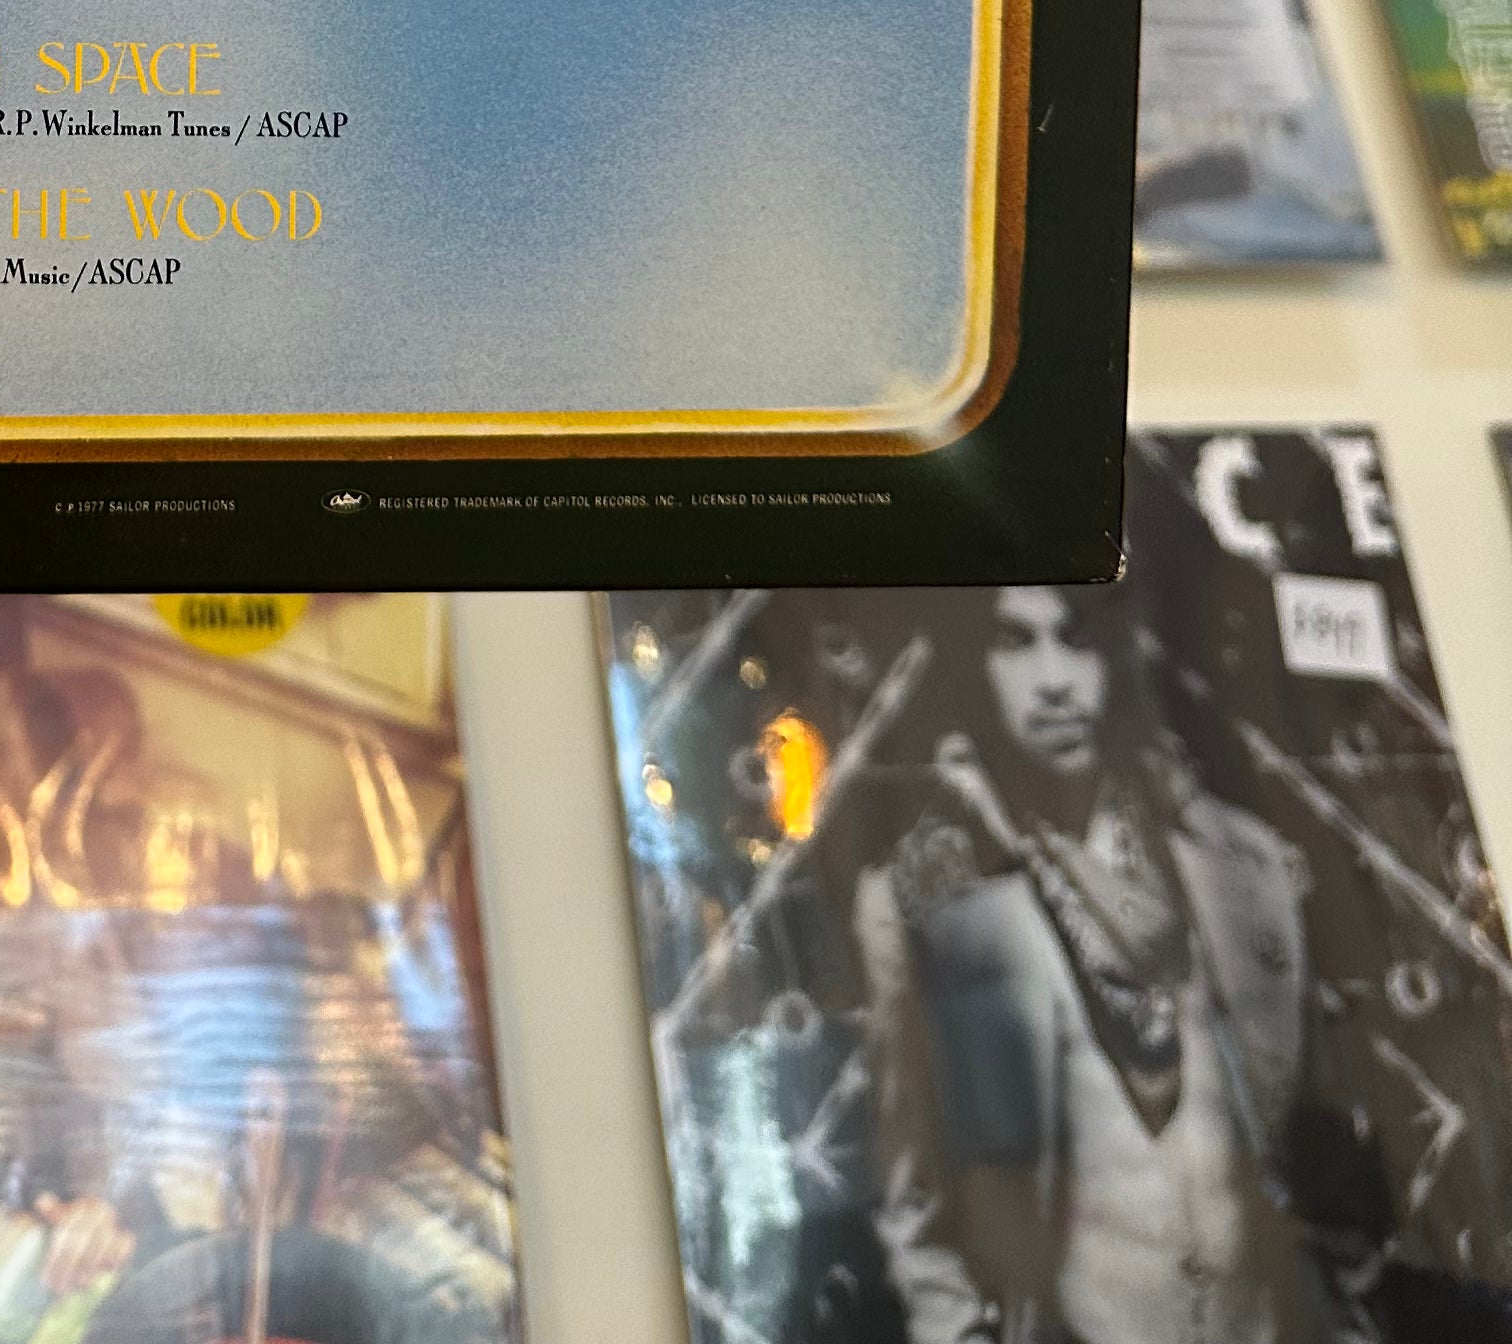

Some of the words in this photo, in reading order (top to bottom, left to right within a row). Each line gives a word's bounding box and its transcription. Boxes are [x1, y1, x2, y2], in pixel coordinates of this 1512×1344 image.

[35, 43, 220, 94] SPACE
[124, 189, 322, 240] WOOD
[78, 501, 104, 512] 1977
[109, 500, 149, 512] SAILOR
[155, 500, 235, 512] PRODUCTIONS
[379, 497, 449, 509] REGISTERED
[454, 497, 522, 508] TRADEMARK
[525, 496, 538, 507] OF
[543, 496, 590, 508] CAPITOL
[692, 494, 746, 505] LICENSED
[751, 494, 765, 505] TO
[769, 494, 808, 505] SAILOR
[812, 493, 891, 504] PRODUCTIONS
